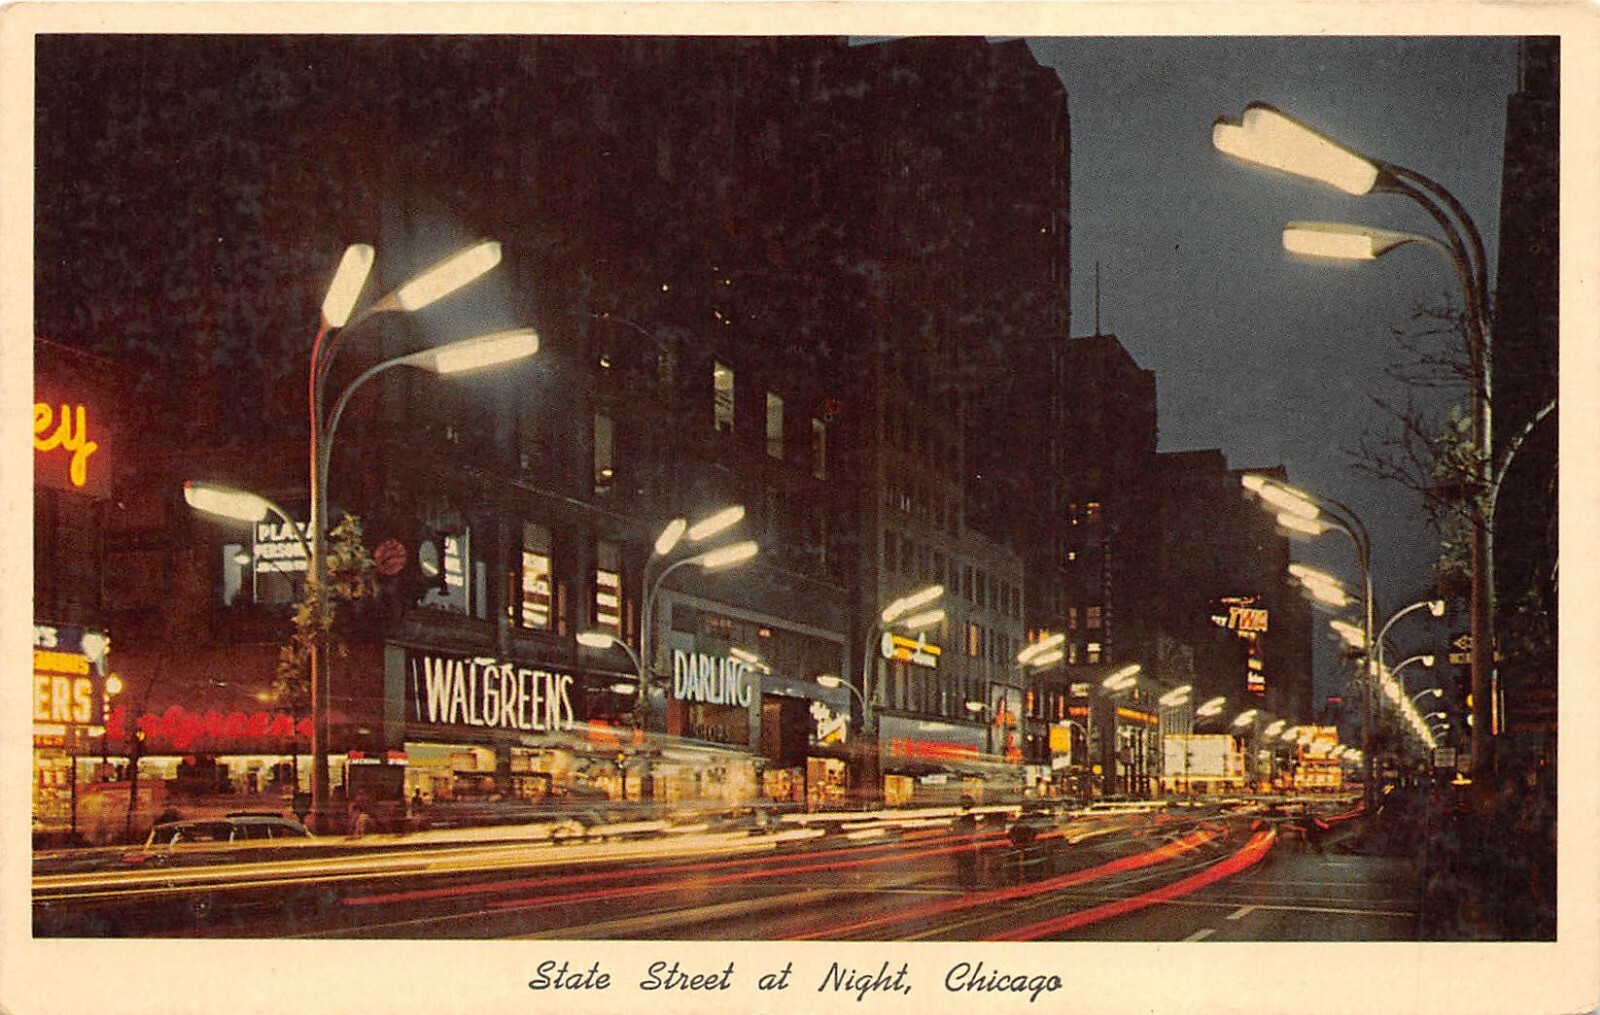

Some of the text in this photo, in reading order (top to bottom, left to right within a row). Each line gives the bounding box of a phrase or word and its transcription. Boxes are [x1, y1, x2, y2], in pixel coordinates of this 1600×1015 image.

[1227, 605, 1268, 632] TWA
[34, 675, 93, 723] ERS
[424, 656, 574, 731] WALGREENS
